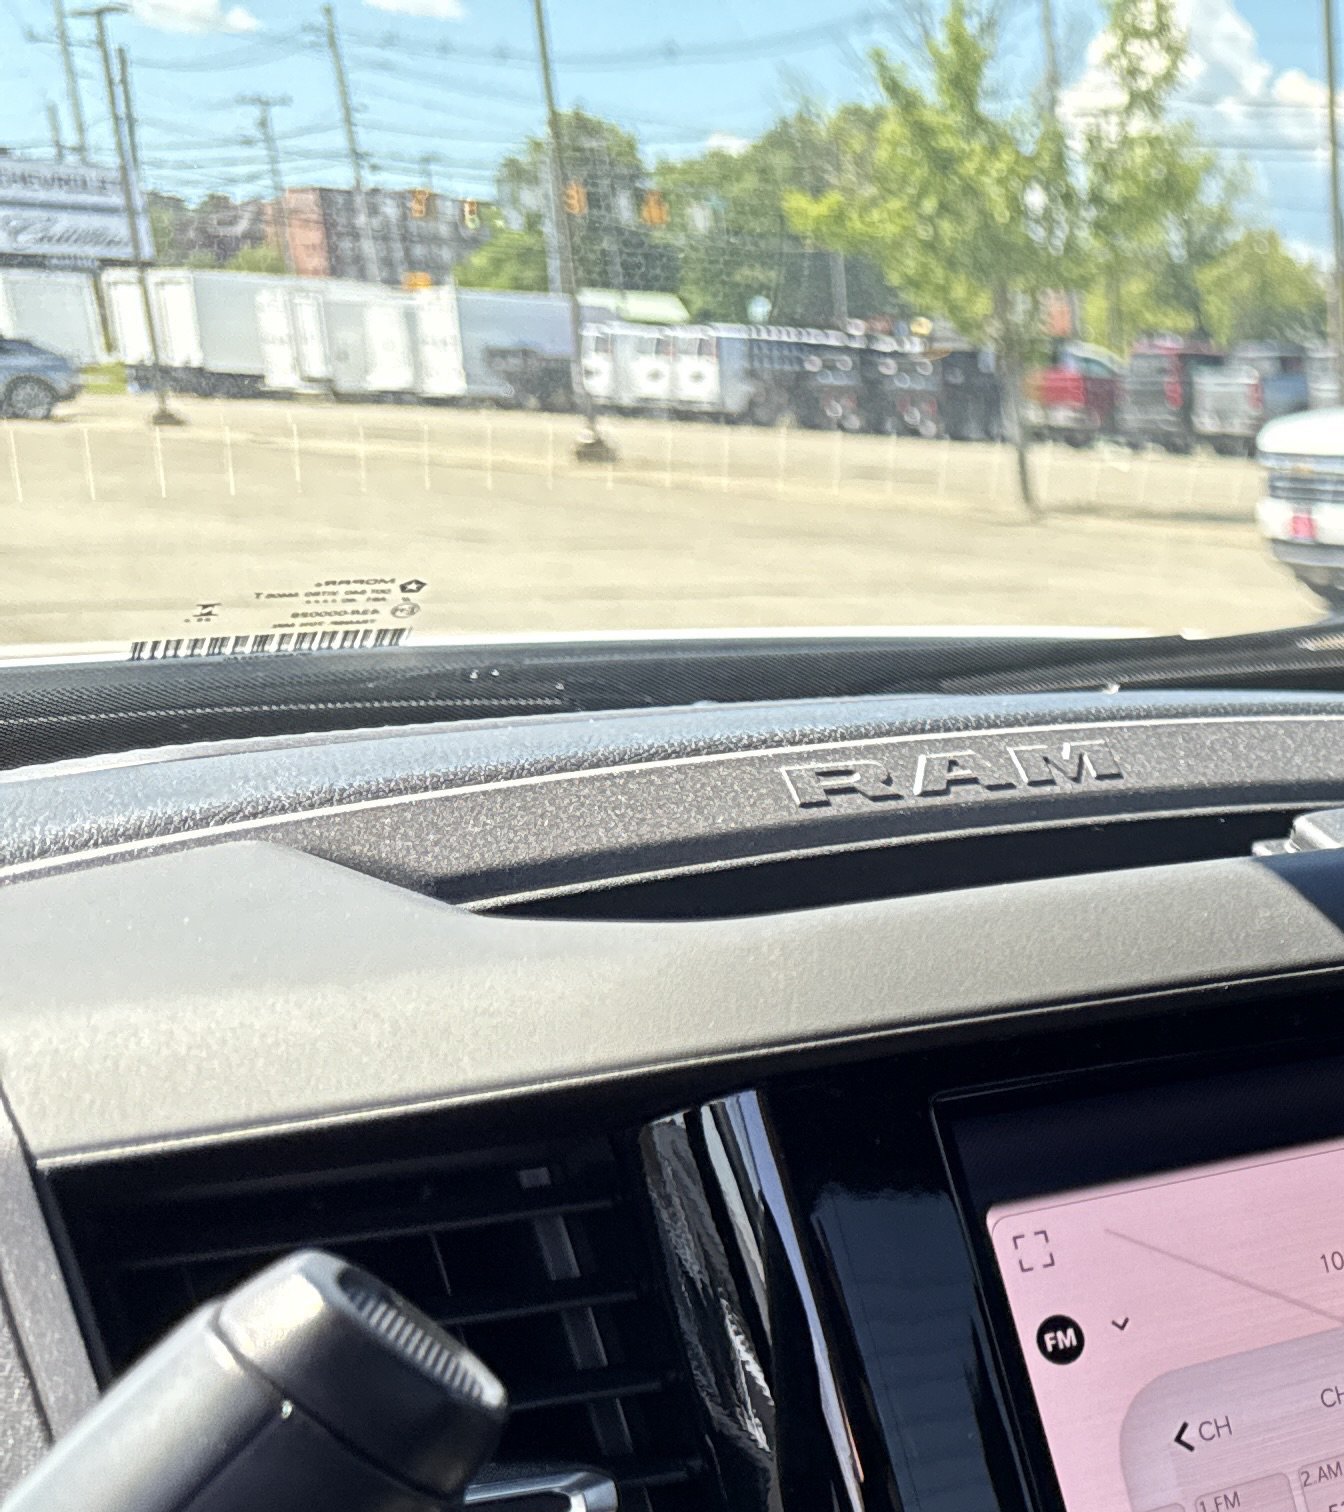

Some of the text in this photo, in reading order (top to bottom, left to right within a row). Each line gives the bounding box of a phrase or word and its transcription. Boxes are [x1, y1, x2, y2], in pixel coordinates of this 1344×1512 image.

[783, 740, 1127, 810] RAM
[1044, 1328, 1078, 1353] FM
[1198, 1415, 1234, 1442] CH
